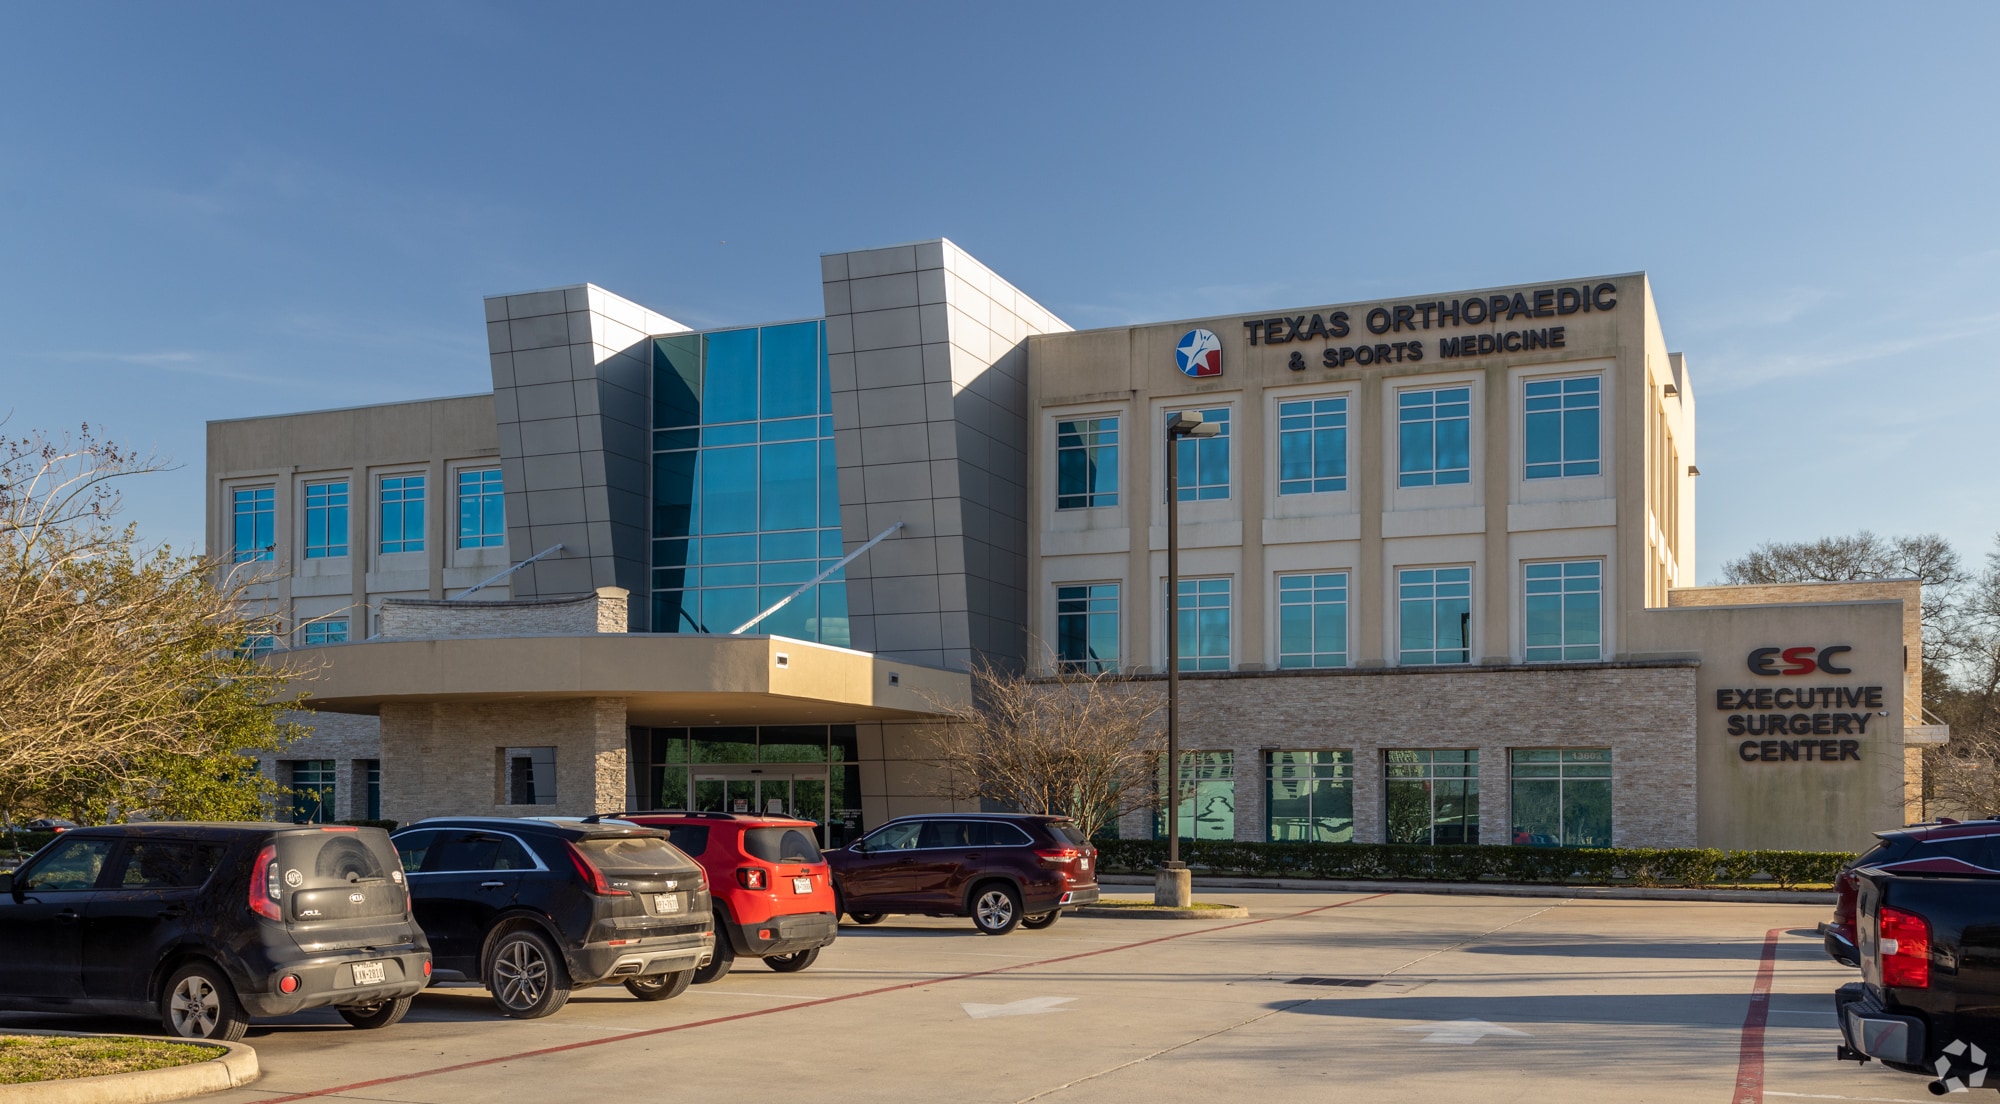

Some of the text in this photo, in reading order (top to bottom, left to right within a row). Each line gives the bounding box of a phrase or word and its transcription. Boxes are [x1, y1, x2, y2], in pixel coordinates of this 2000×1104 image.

[1243, 282, 1617, 346] TEXAS ORTHOPAEDIC
[1288, 326, 1566, 371] & SPORTS MEDICINE
[1747, 646, 1852, 676] ESC
[1716, 686, 1883, 710] EXECUTIVE
[1727, 712, 1872, 736] SURGERY
[1739, 739, 1861, 762] CENTER
